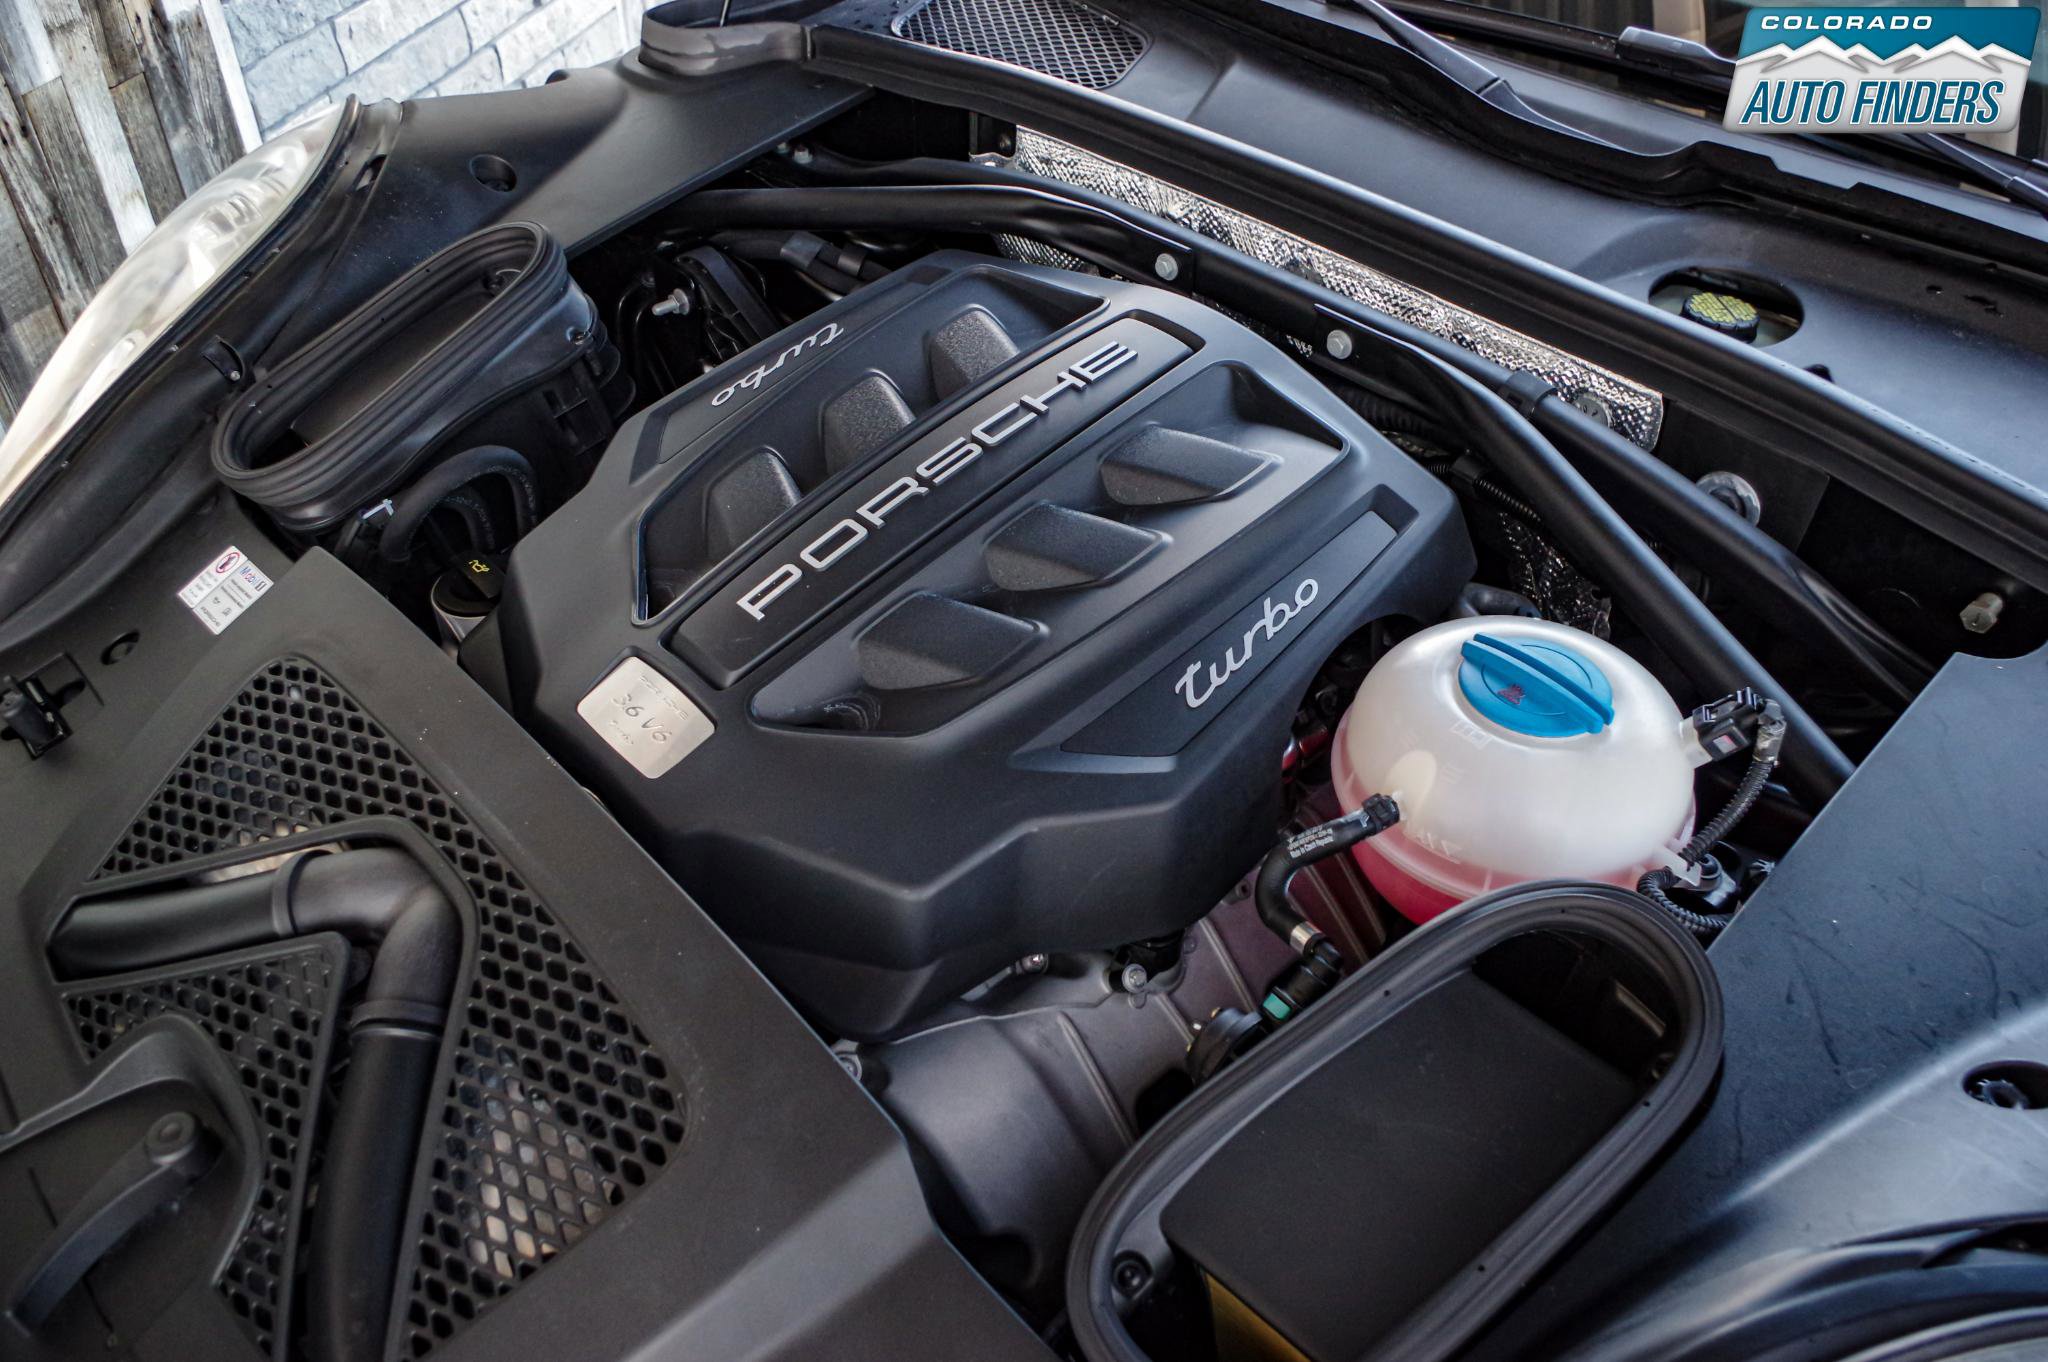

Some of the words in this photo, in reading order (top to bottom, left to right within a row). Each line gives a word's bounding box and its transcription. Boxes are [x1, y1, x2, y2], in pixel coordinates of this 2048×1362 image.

[711, 322, 844, 407] turbo
[736, 340, 1138, 621] PORSCHE
[1174, 578, 1319, 709] turbo
[641, 717, 673, 744] V6
